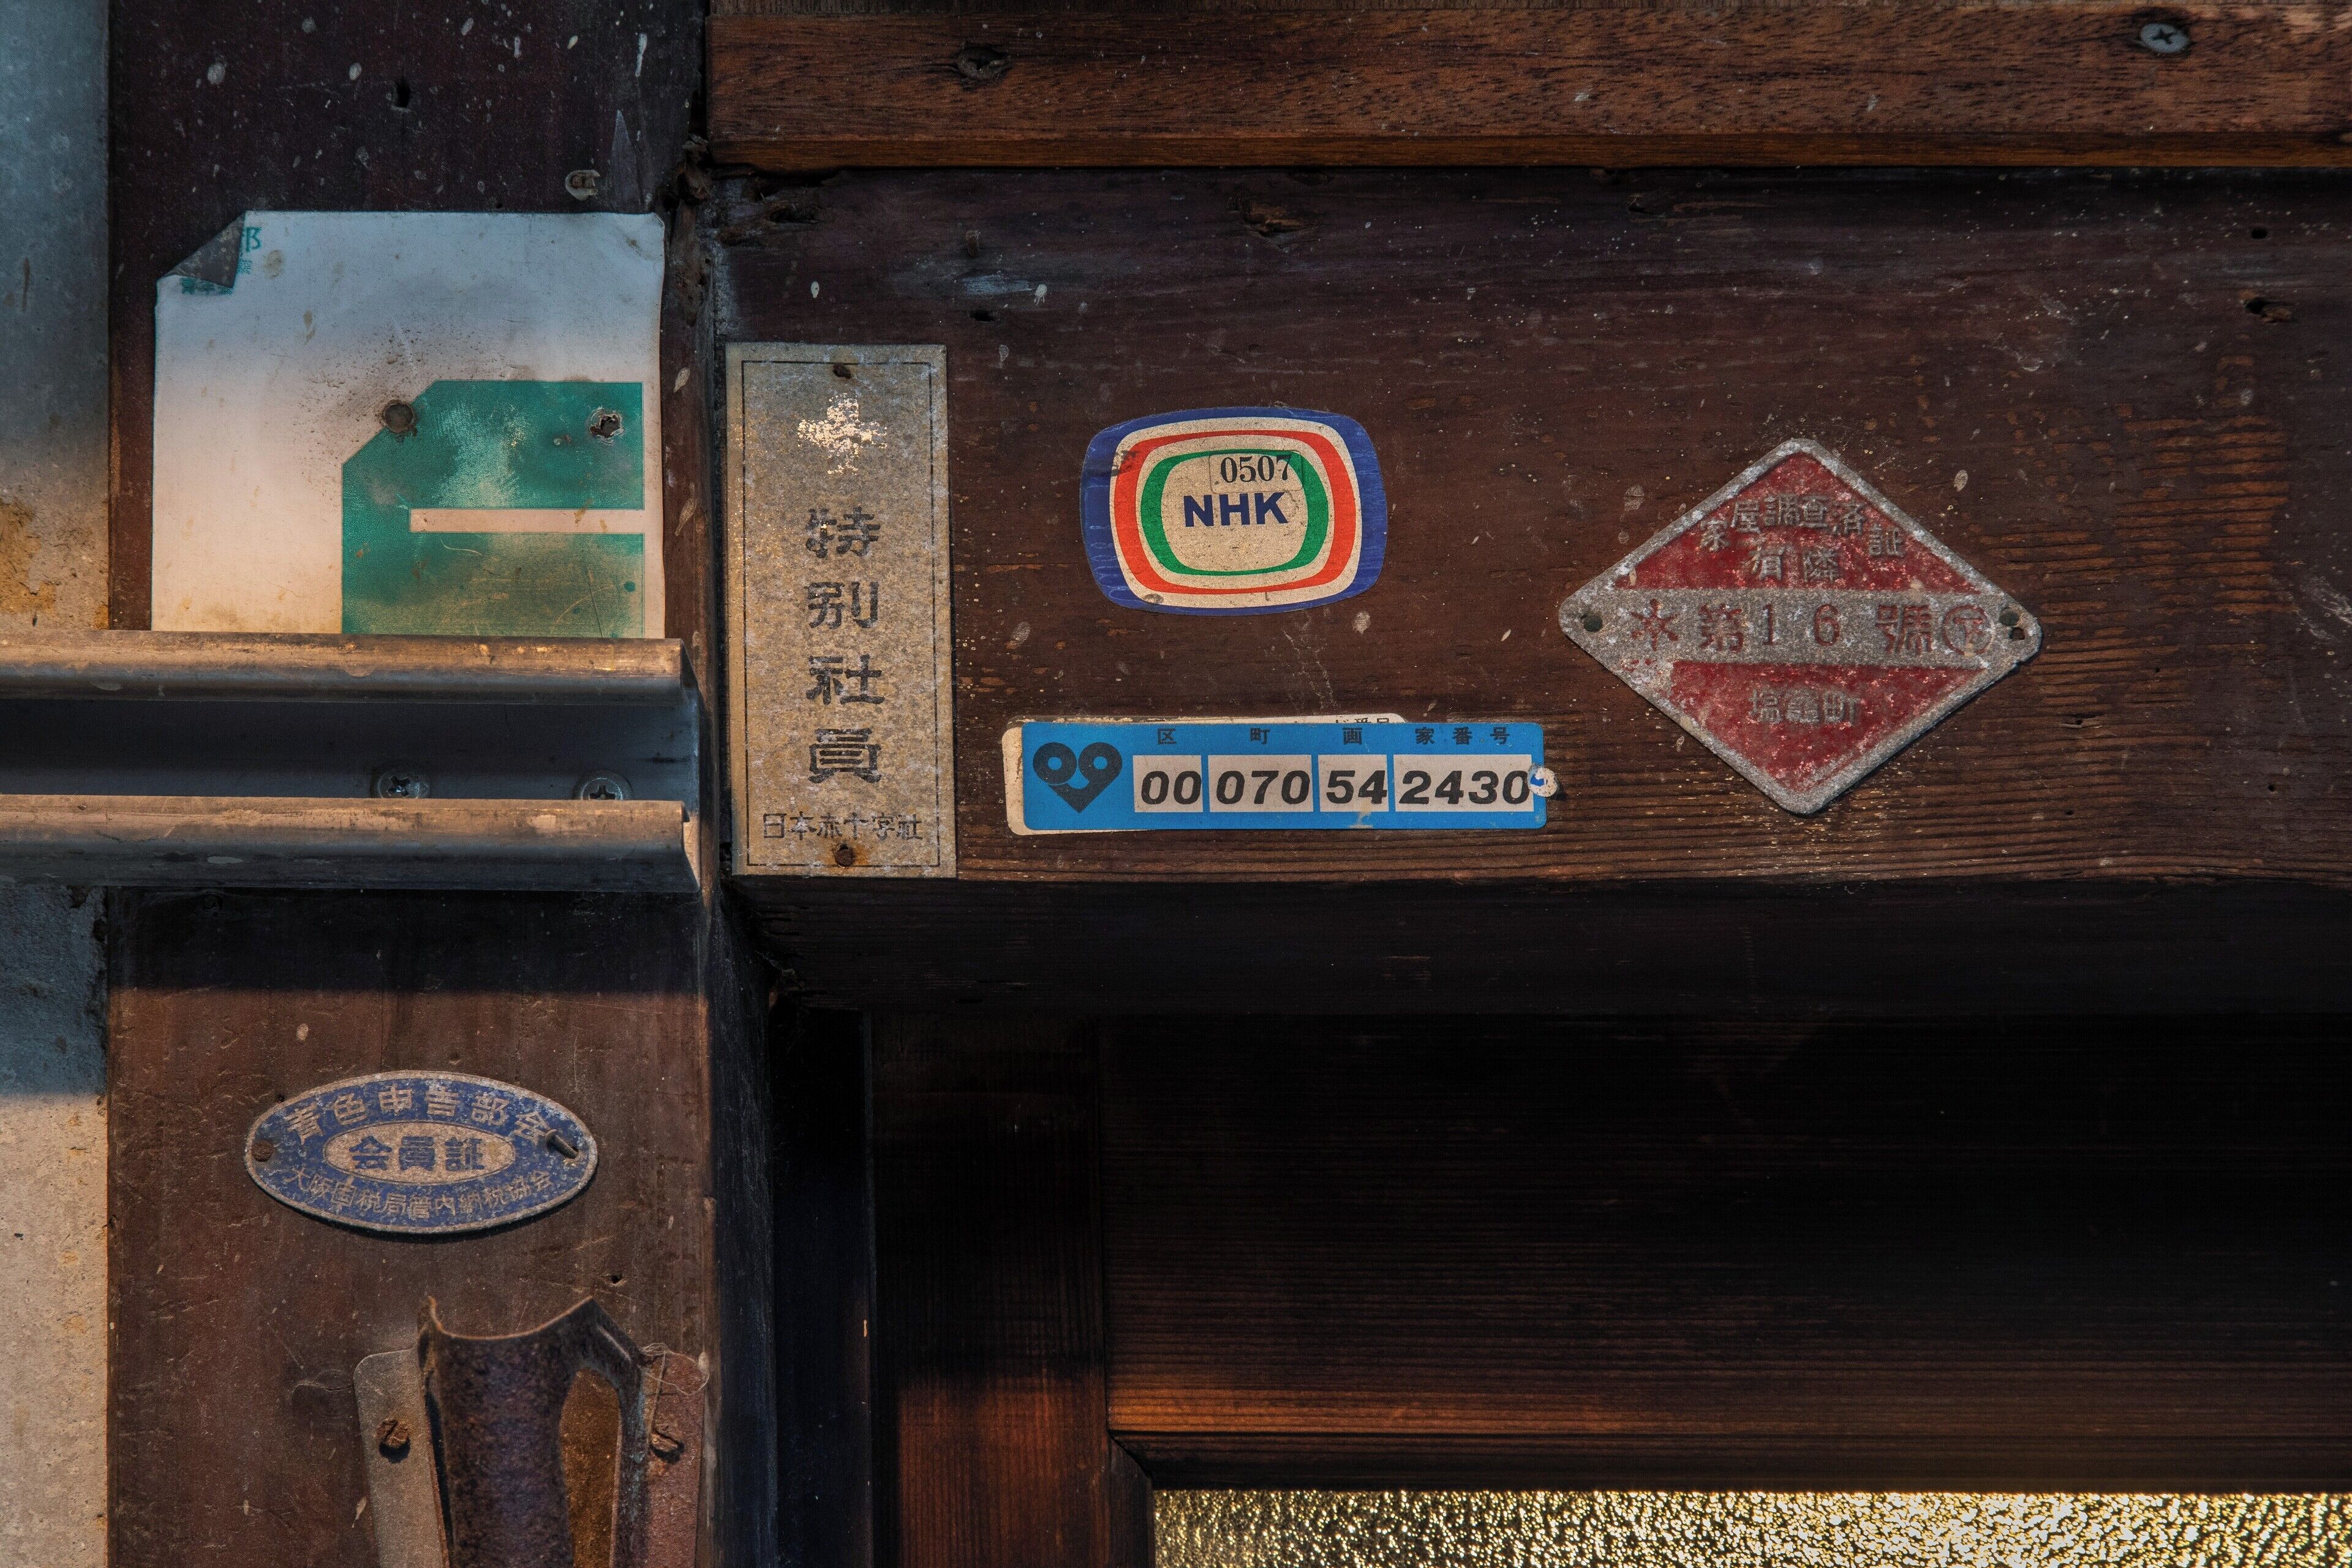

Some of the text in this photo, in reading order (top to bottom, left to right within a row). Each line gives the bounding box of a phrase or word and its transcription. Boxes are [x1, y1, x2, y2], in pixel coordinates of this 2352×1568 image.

[1219, 454, 1294, 483] 0507
[1183, 492, 1288, 527] NHK
[805, 505, 885, 784] 特別社員
[1157, 727, 1177, 745] 区
[1250, 727, 1271, 745] 町
[1342, 726, 1363, 745] 画
[1140, 769, 1530, 805] 00 070 54 2430
[763, 810, 924, 841] 日本赤十字社
[284, 1084, 552, 1145] 青色申告部会
[348, 1135, 484, 1171] 会員証
